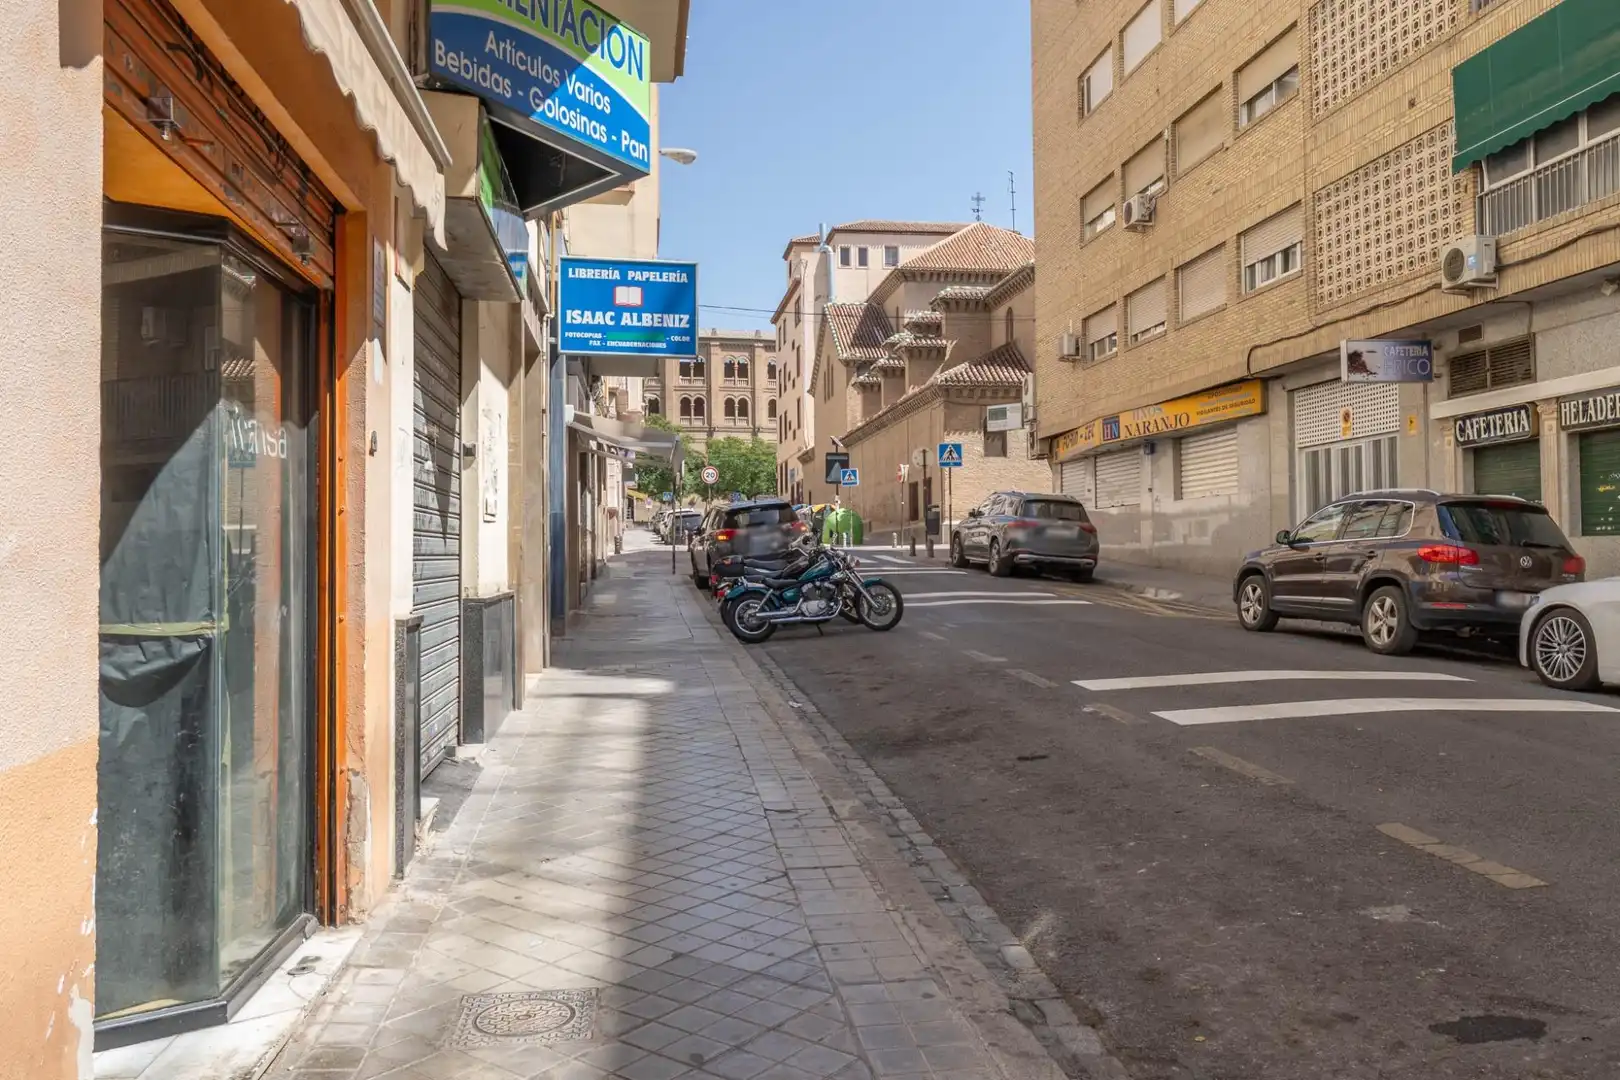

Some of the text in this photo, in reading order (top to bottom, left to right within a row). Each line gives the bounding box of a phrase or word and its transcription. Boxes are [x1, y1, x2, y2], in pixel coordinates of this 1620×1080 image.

[434, 39, 511, 99] Bebidas
[529, 86, 607, 144] Golosinas
[621, 130, 648, 163] Pan
[564, 68, 611, 114] Varios
[568, 267, 688, 283] LIBRERÍA PAPELERÍA
[566, 310, 690, 328] ISAAC ALBENIZ
[565, 331, 602, 339] FOTOCOPIAS
[1124, 412, 1190, 438] NARANJO
[1456, 409, 1529, 442] CAFETERIA
[706, 471, 715, 479] 20
